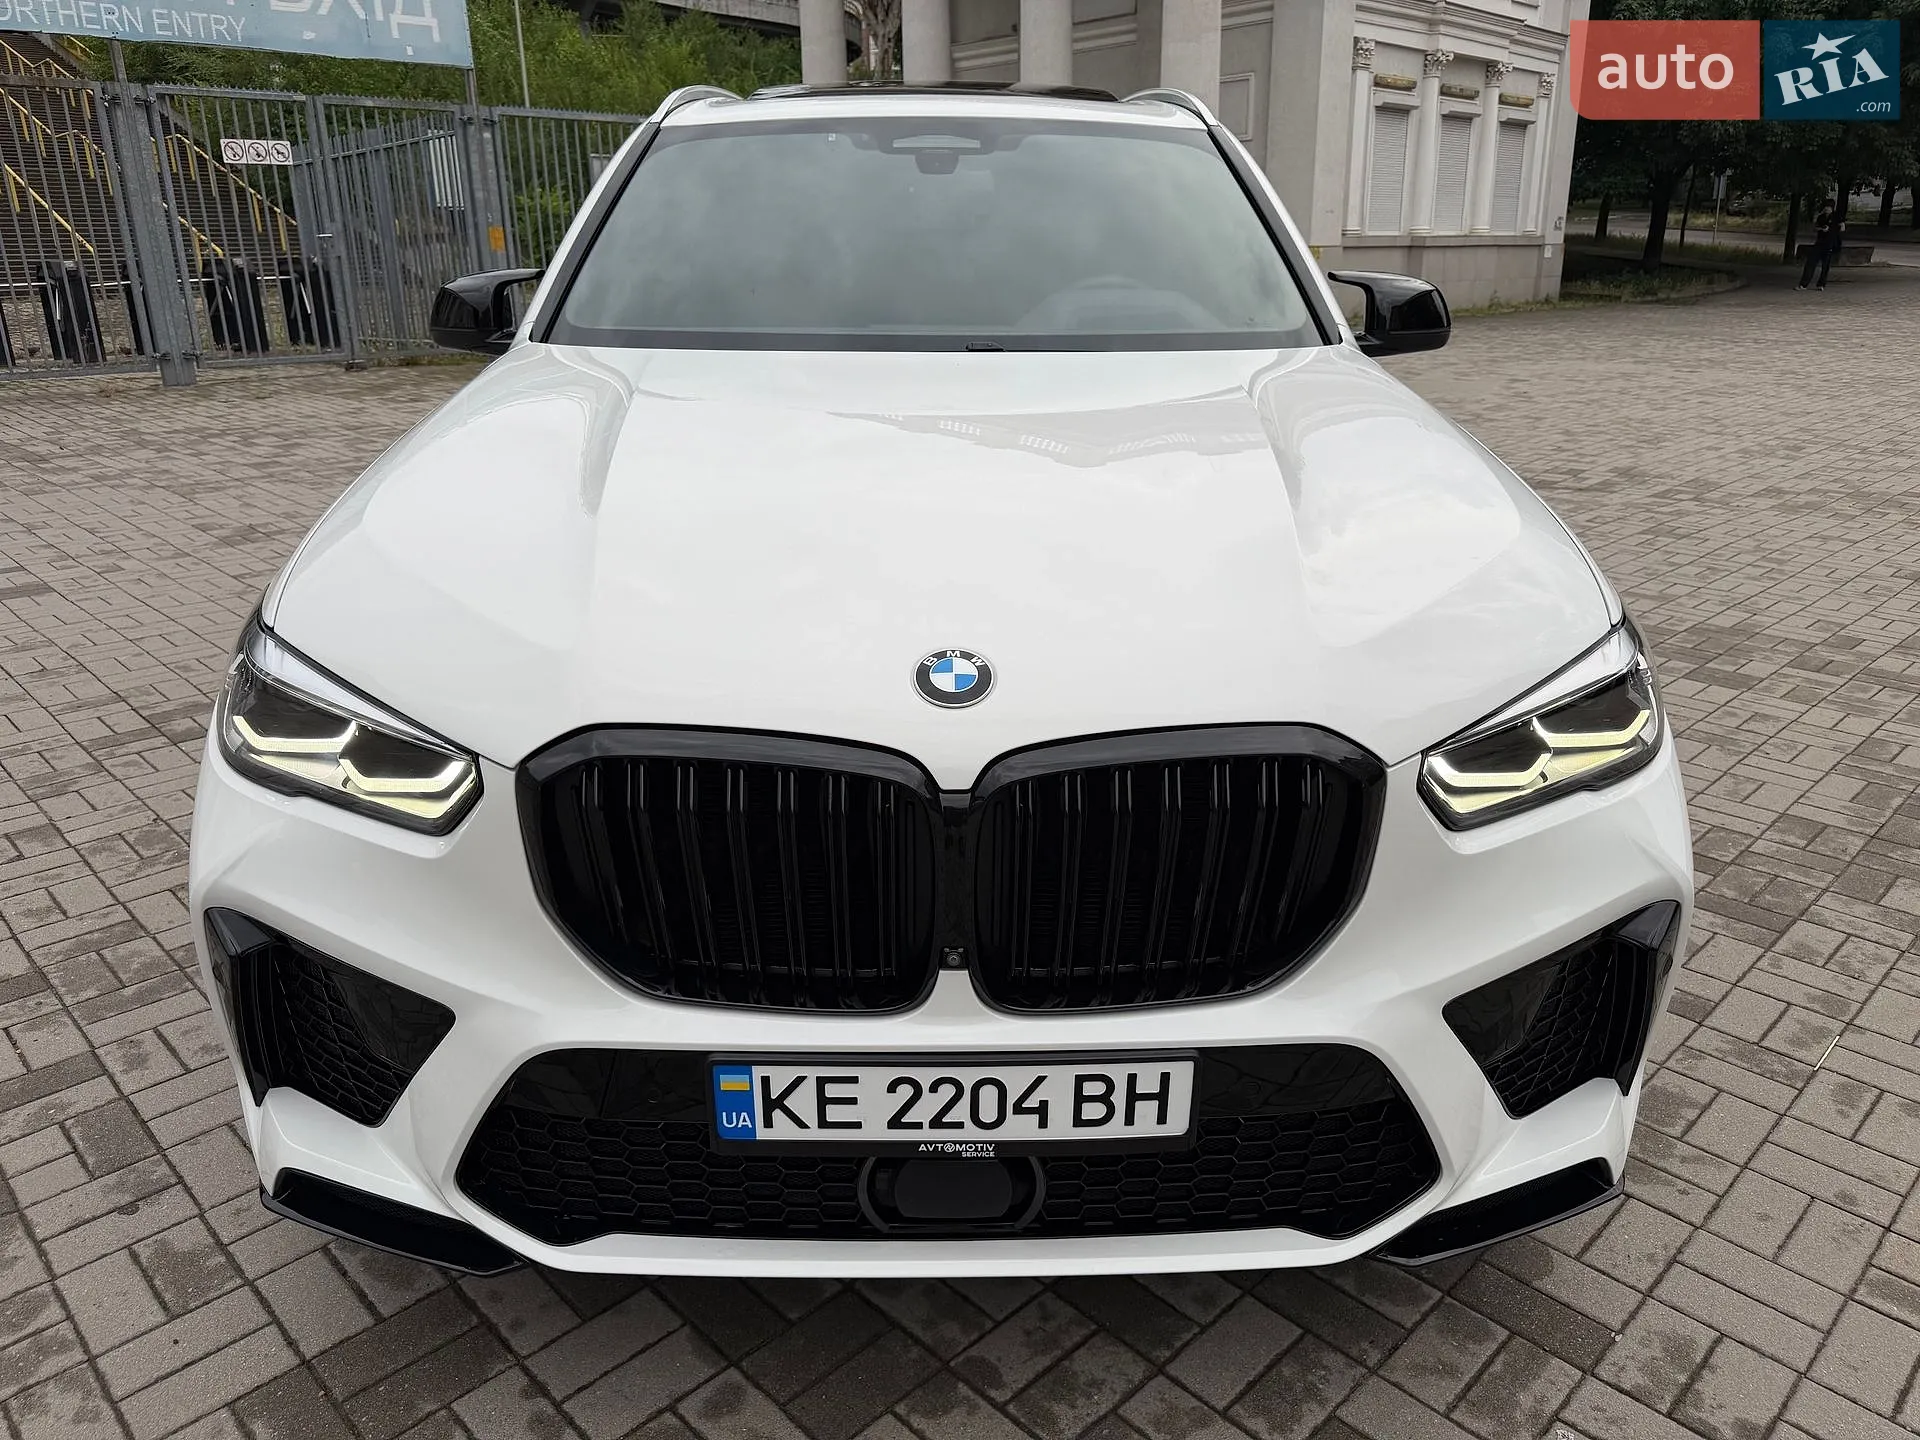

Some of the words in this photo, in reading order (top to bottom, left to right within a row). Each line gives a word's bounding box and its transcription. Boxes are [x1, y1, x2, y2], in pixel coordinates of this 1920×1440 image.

[152, 9, 245, 41] ENTRY
[922, 650, 986, 667] BMW
[760, 1075, 863, 1129] KE
[886, 1075, 1049, 1130] 2204
[1072, 1071, 1171, 1128] BH
[722, 1111, 753, 1128] UA
